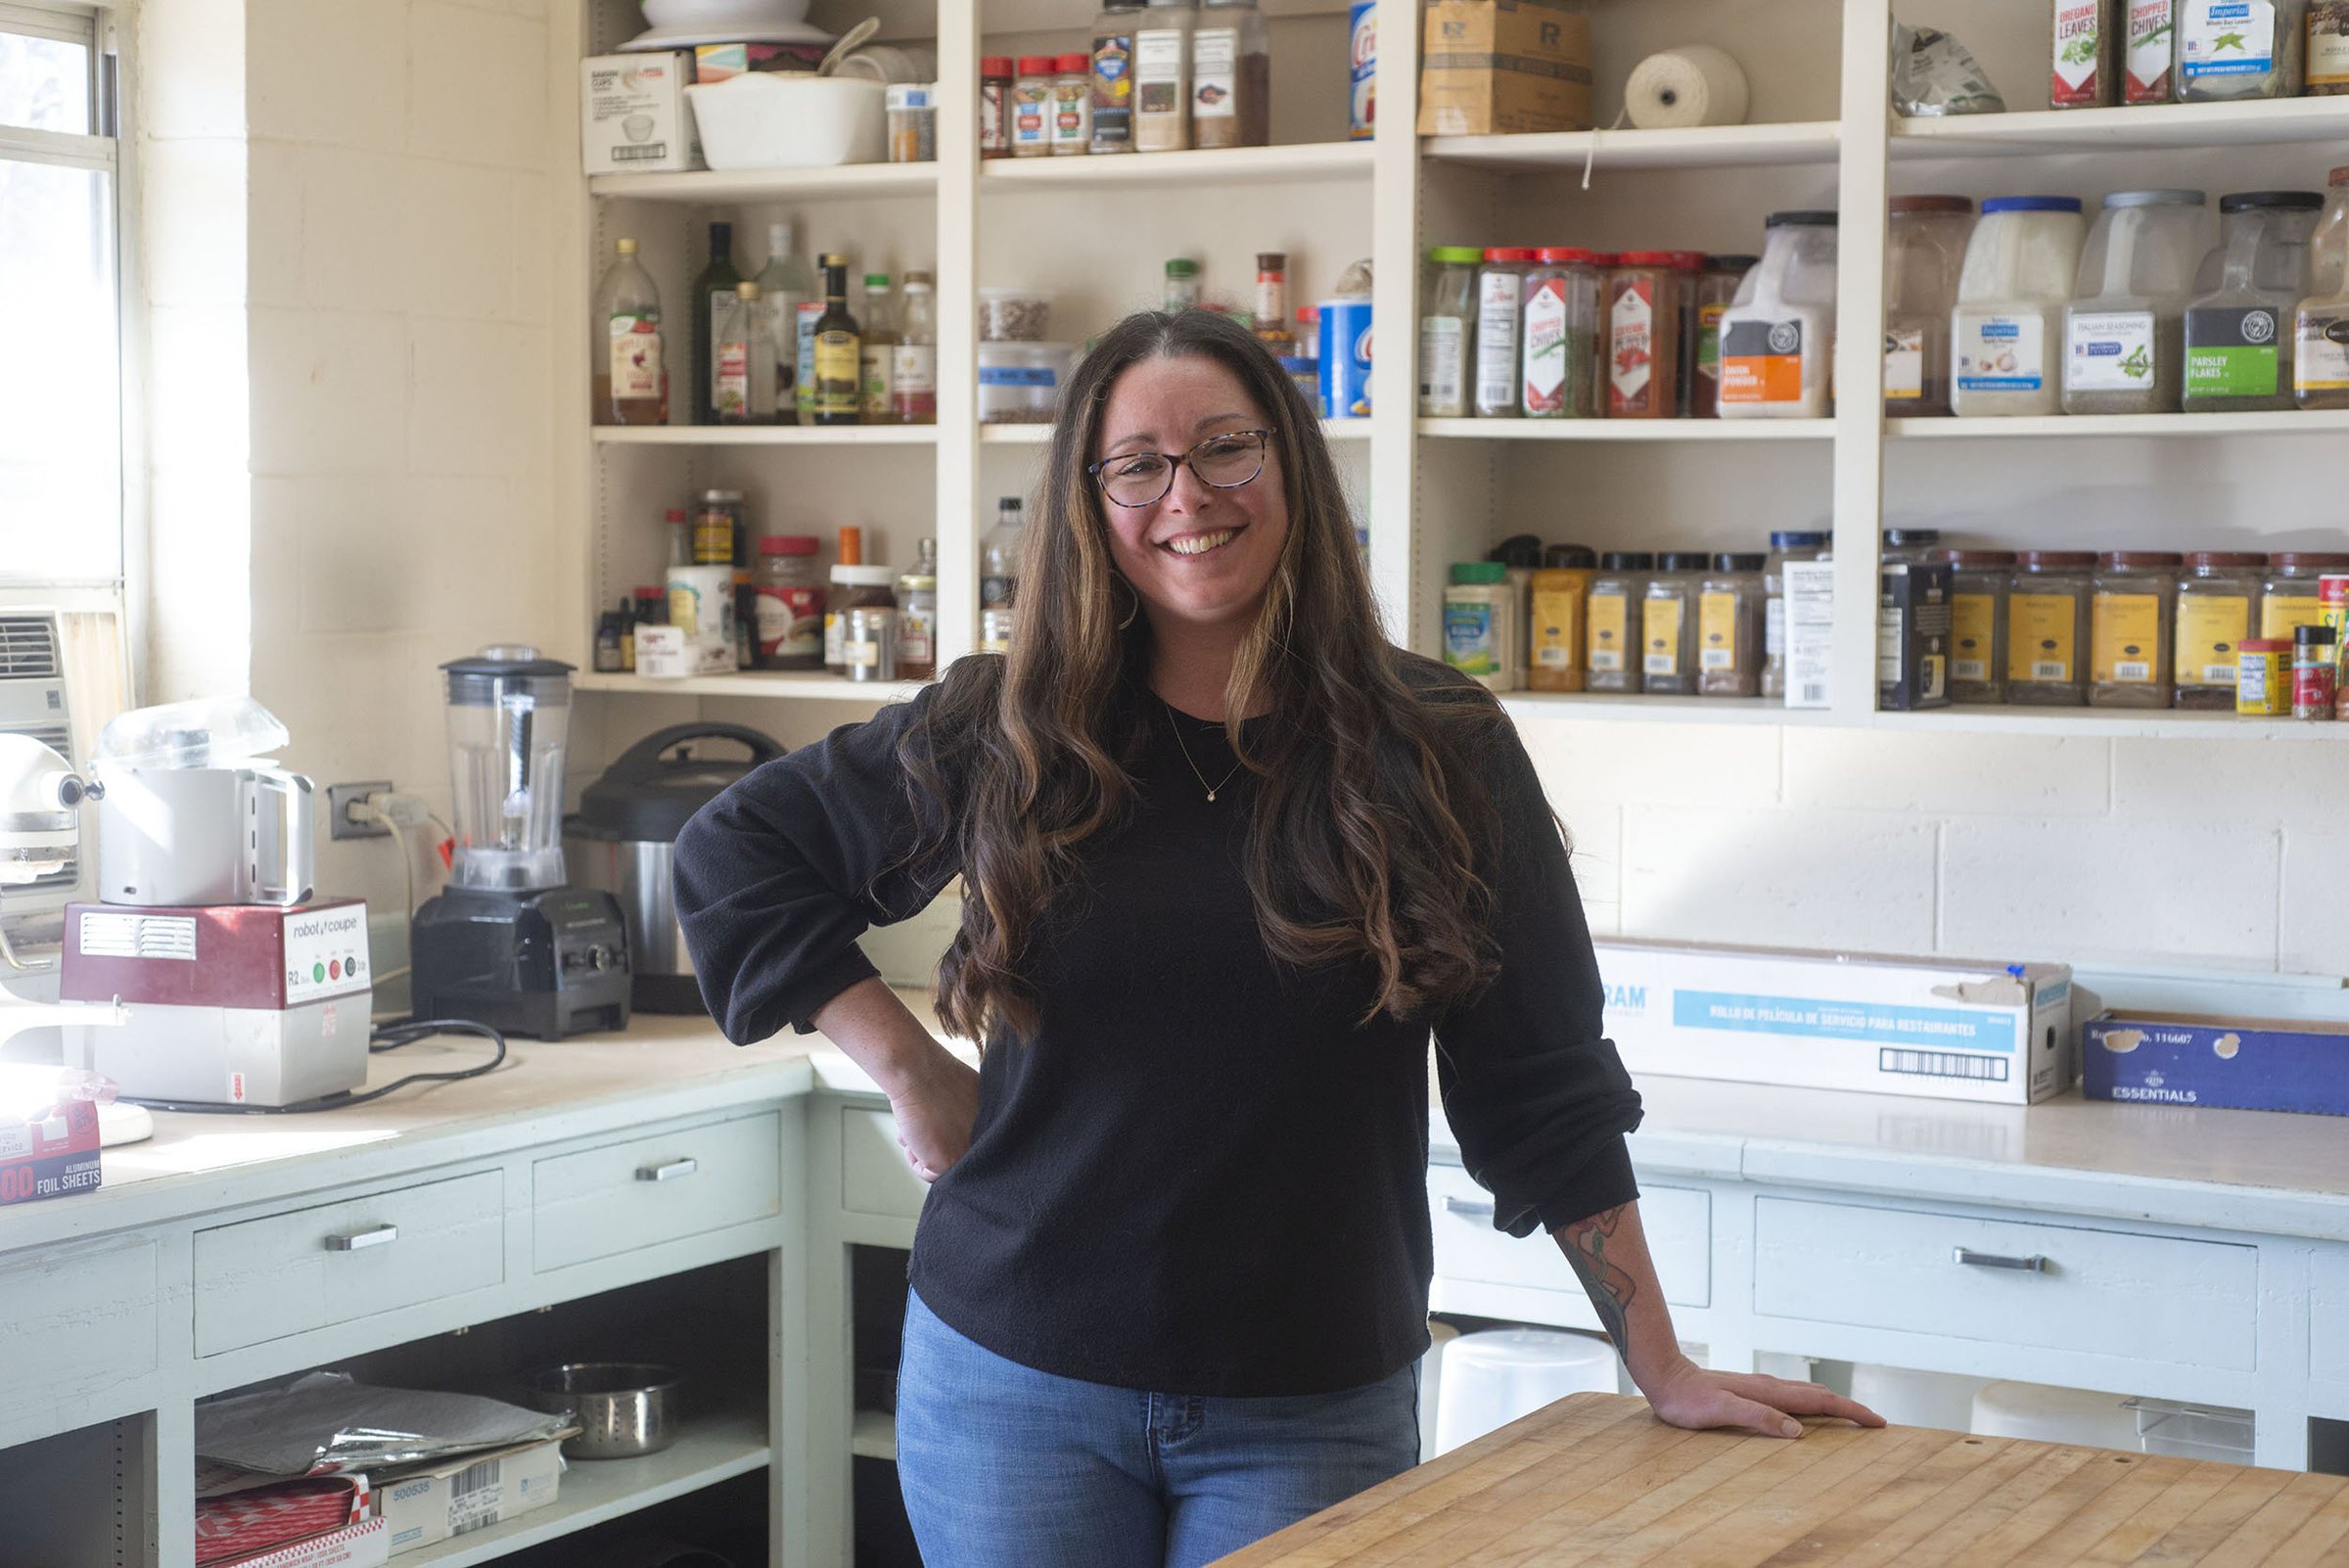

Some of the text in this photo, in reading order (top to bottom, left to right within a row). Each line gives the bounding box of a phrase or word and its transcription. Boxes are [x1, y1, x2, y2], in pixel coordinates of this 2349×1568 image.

[2131, 0, 2169, 20] CHOPPED
[2210, 4, 2249, 18] Imperial
[2059, 17, 2096, 39] LEAVES
[2131, 14, 2168, 36] CHIVES
[2190, 356, 2228, 366] PARSLEY
[2190, 368, 2221, 378] FLAKES
[328, 917, 357, 933] coupe
[288, 970, 299, 987] R2
[1603, 985, 1646, 1008] RAM
[1710, 1004, 1740, 1019] ROLLO
[1743, 1007, 1755, 1020] DE
[1758, 1005, 1804, 1025] PELÍCULA
[1806, 1012, 1819, 1025] DE
[1820, 1013, 1866, 1029] SERVICIO
[1868, 1017, 1896, 1031] PARA
[1897, 1019, 1976, 1038] RESTAURANTES
[2112, 1085, 2197, 1103] ESSENTIALS
[65, 1159, 100, 1175] ALUMINUM
[1, 1165, 34, 1202] 00
[37, 1170, 101, 1195] FOIL SHEETS
